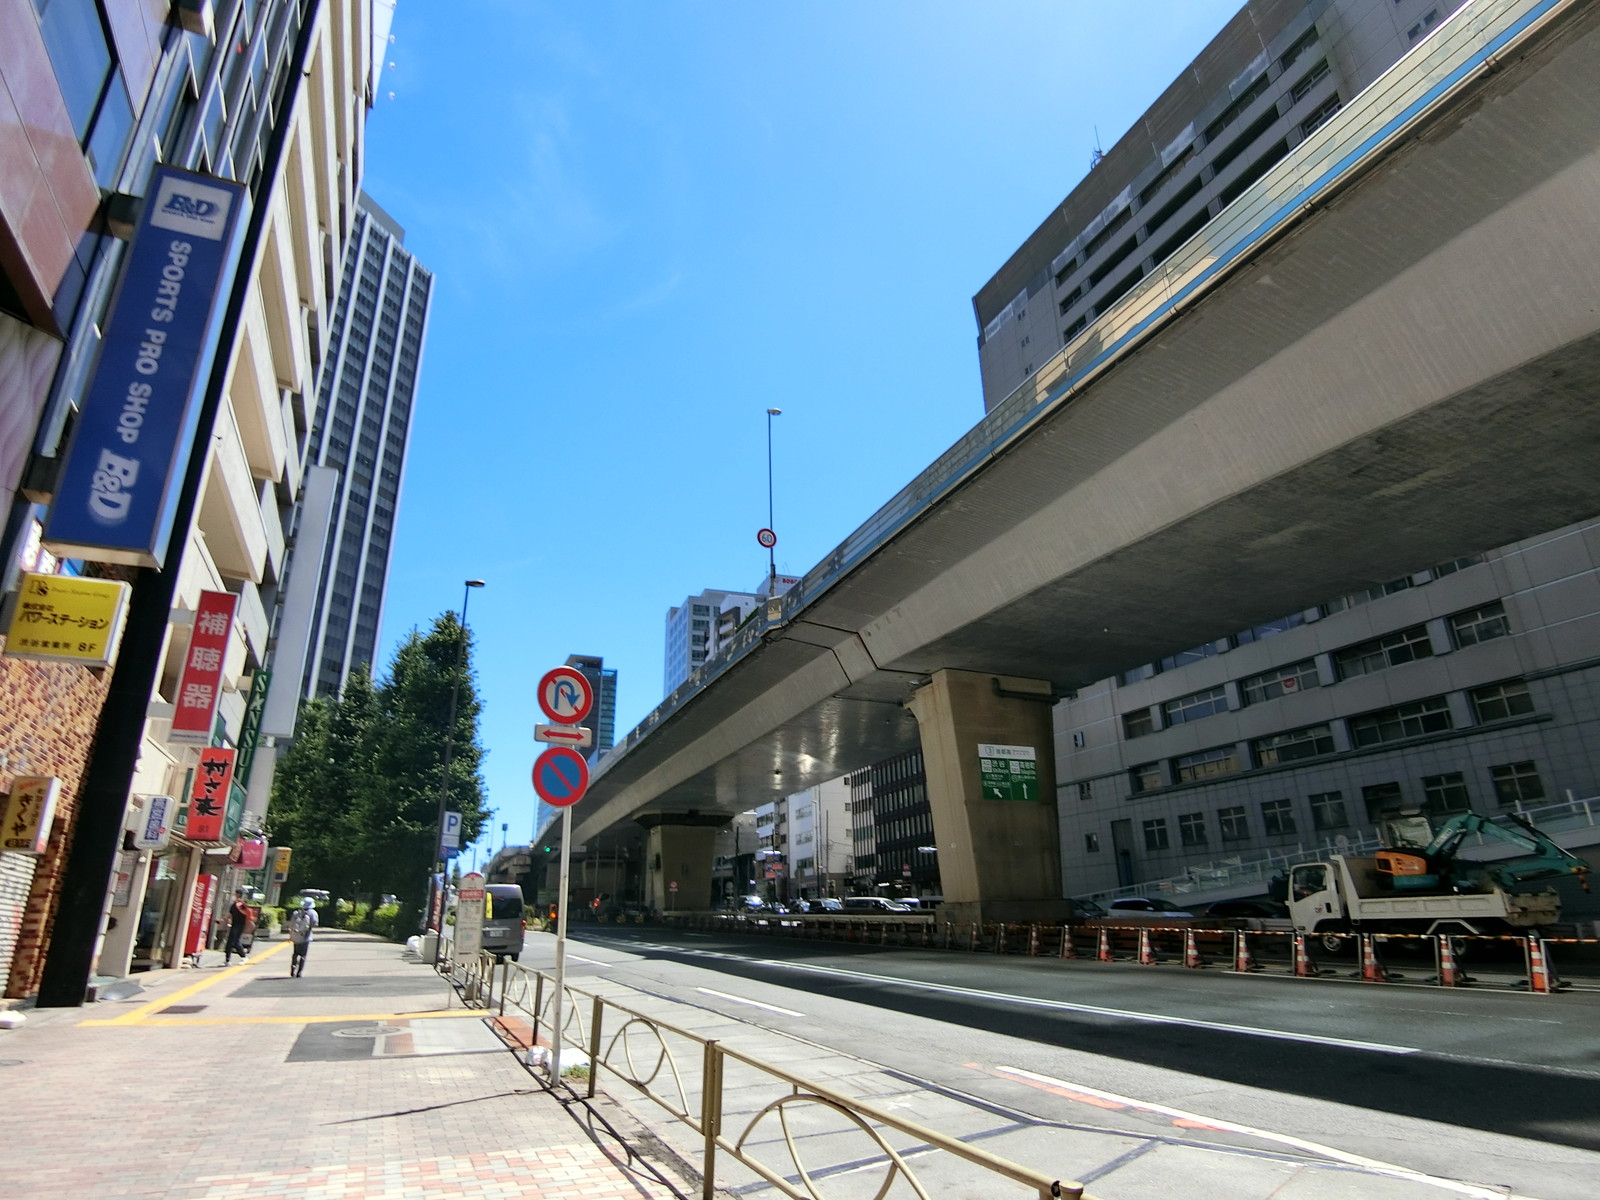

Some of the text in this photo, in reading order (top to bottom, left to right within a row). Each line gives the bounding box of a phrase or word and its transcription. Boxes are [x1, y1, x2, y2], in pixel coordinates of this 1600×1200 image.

[165, 193, 218, 216] B&D
[117, 239, 192, 444] SPORTS PRO SHOP
[89, 448, 140, 521] B&D
[761, 533, 773, 544] 60
[19, 610, 110, 630] パワーステーション
[182, 611, 229, 710] 補聴器
[447, 815, 458, 832] P
